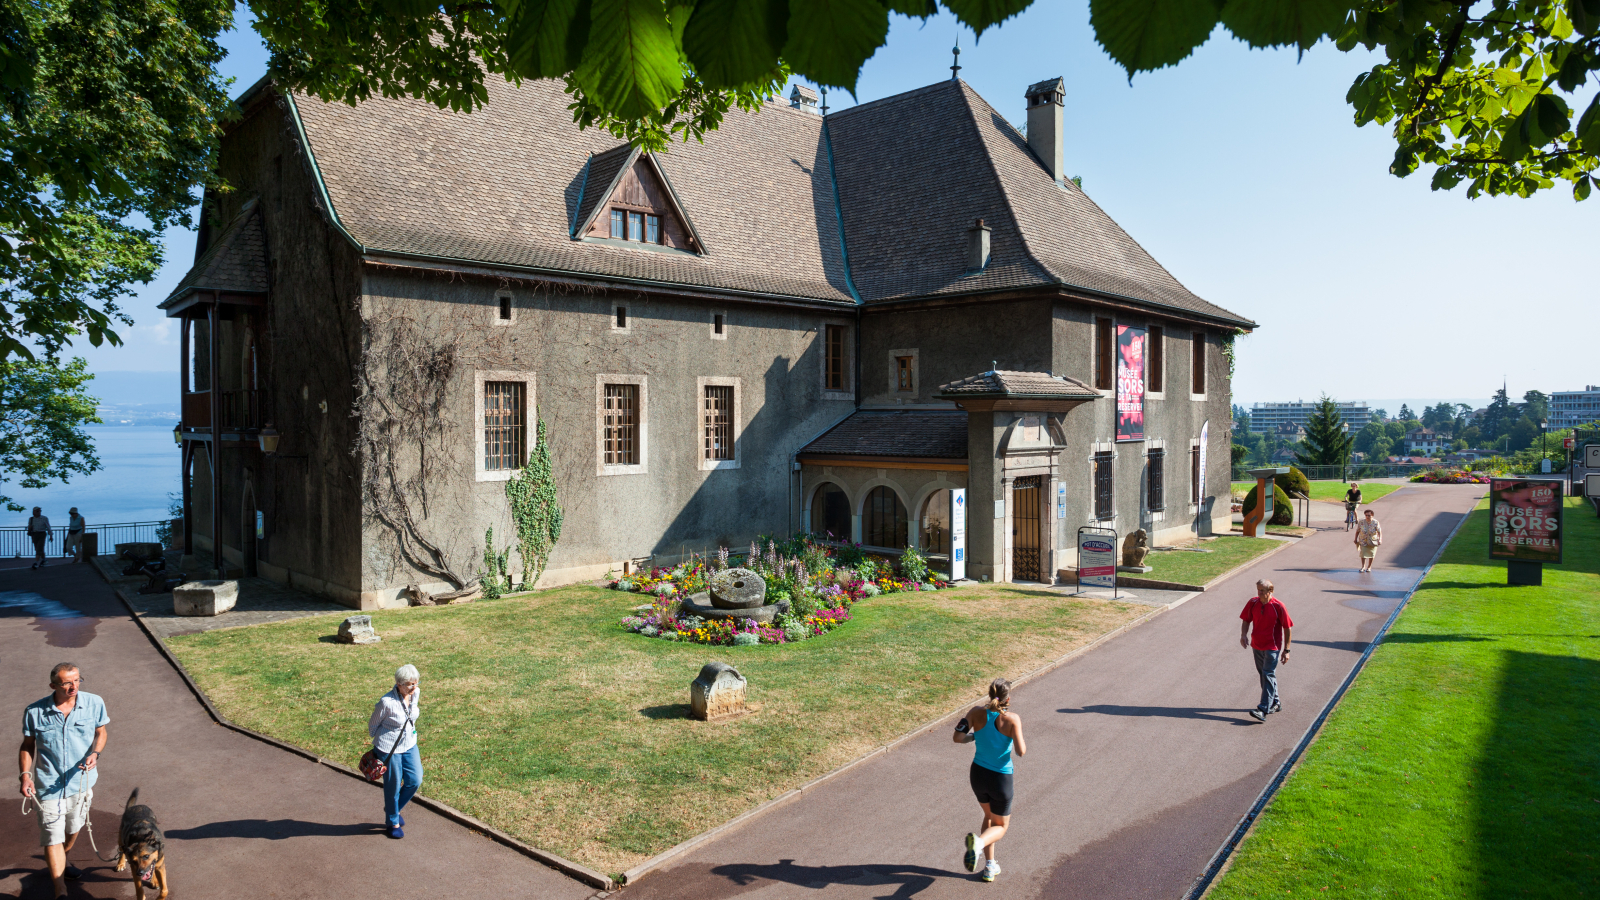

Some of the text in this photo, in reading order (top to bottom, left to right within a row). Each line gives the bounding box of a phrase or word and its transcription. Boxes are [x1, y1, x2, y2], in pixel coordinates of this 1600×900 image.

[1118, 367, 1140, 380] MUSÉE,
[1118, 378, 1144, 394] SORS
[1118, 393, 1125, 401] DE
[1126, 393, 1132, 401] TA
[1532, 488, 1552, 498] 150
[1494, 506, 1548, 518] MUSÉE,
[1495, 515, 1558, 531] SORS
